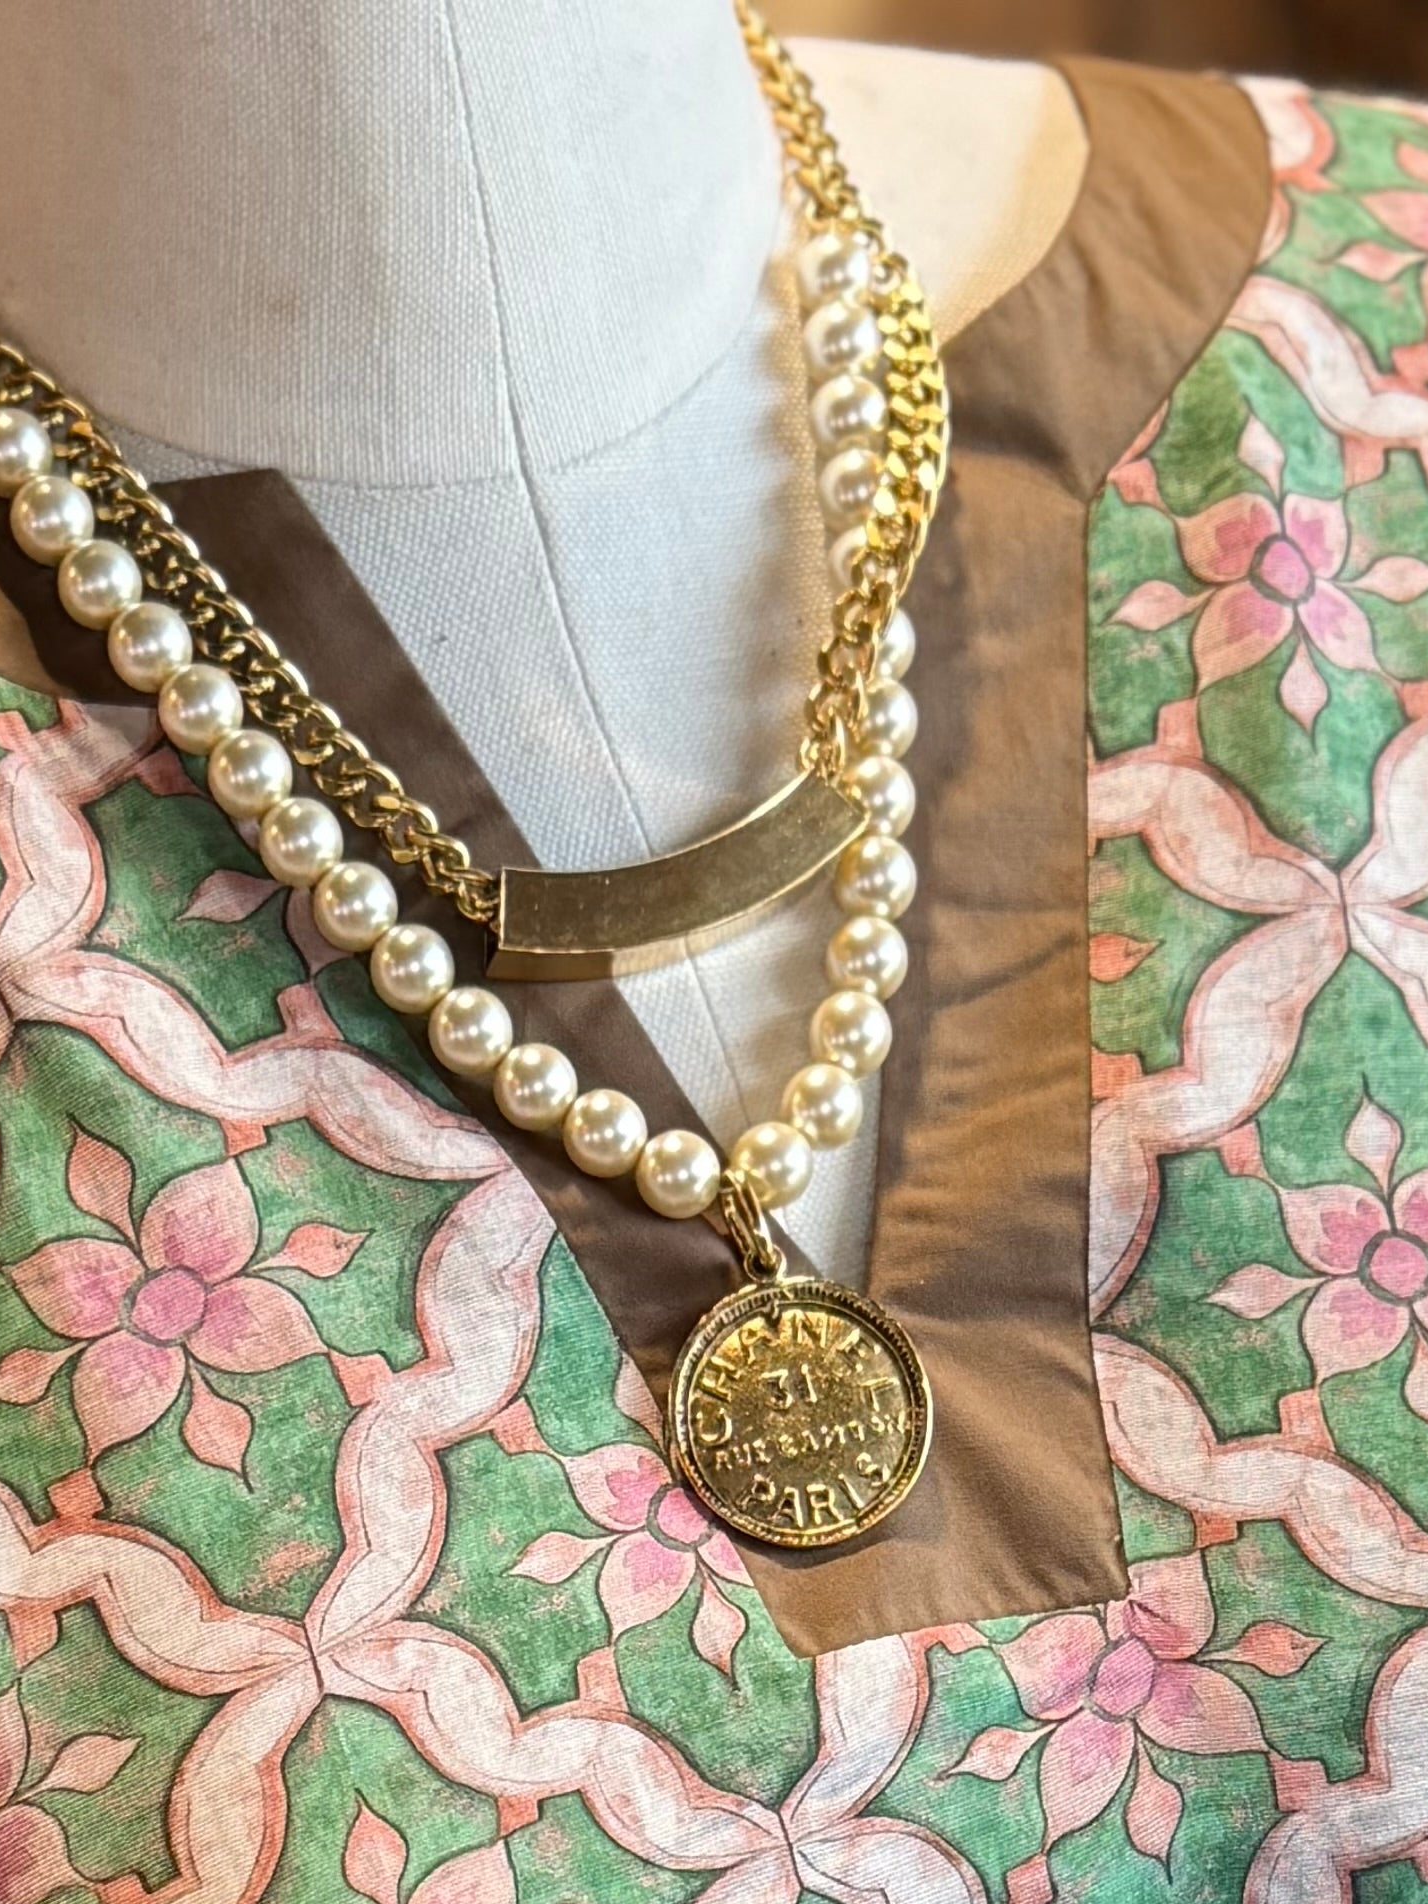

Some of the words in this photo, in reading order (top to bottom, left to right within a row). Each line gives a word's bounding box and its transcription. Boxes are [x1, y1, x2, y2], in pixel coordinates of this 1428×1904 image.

[761, 1364, 817, 1410] 31
[715, 1438, 771, 1471] RUE
[739, 1453, 892, 1528] PARIS
